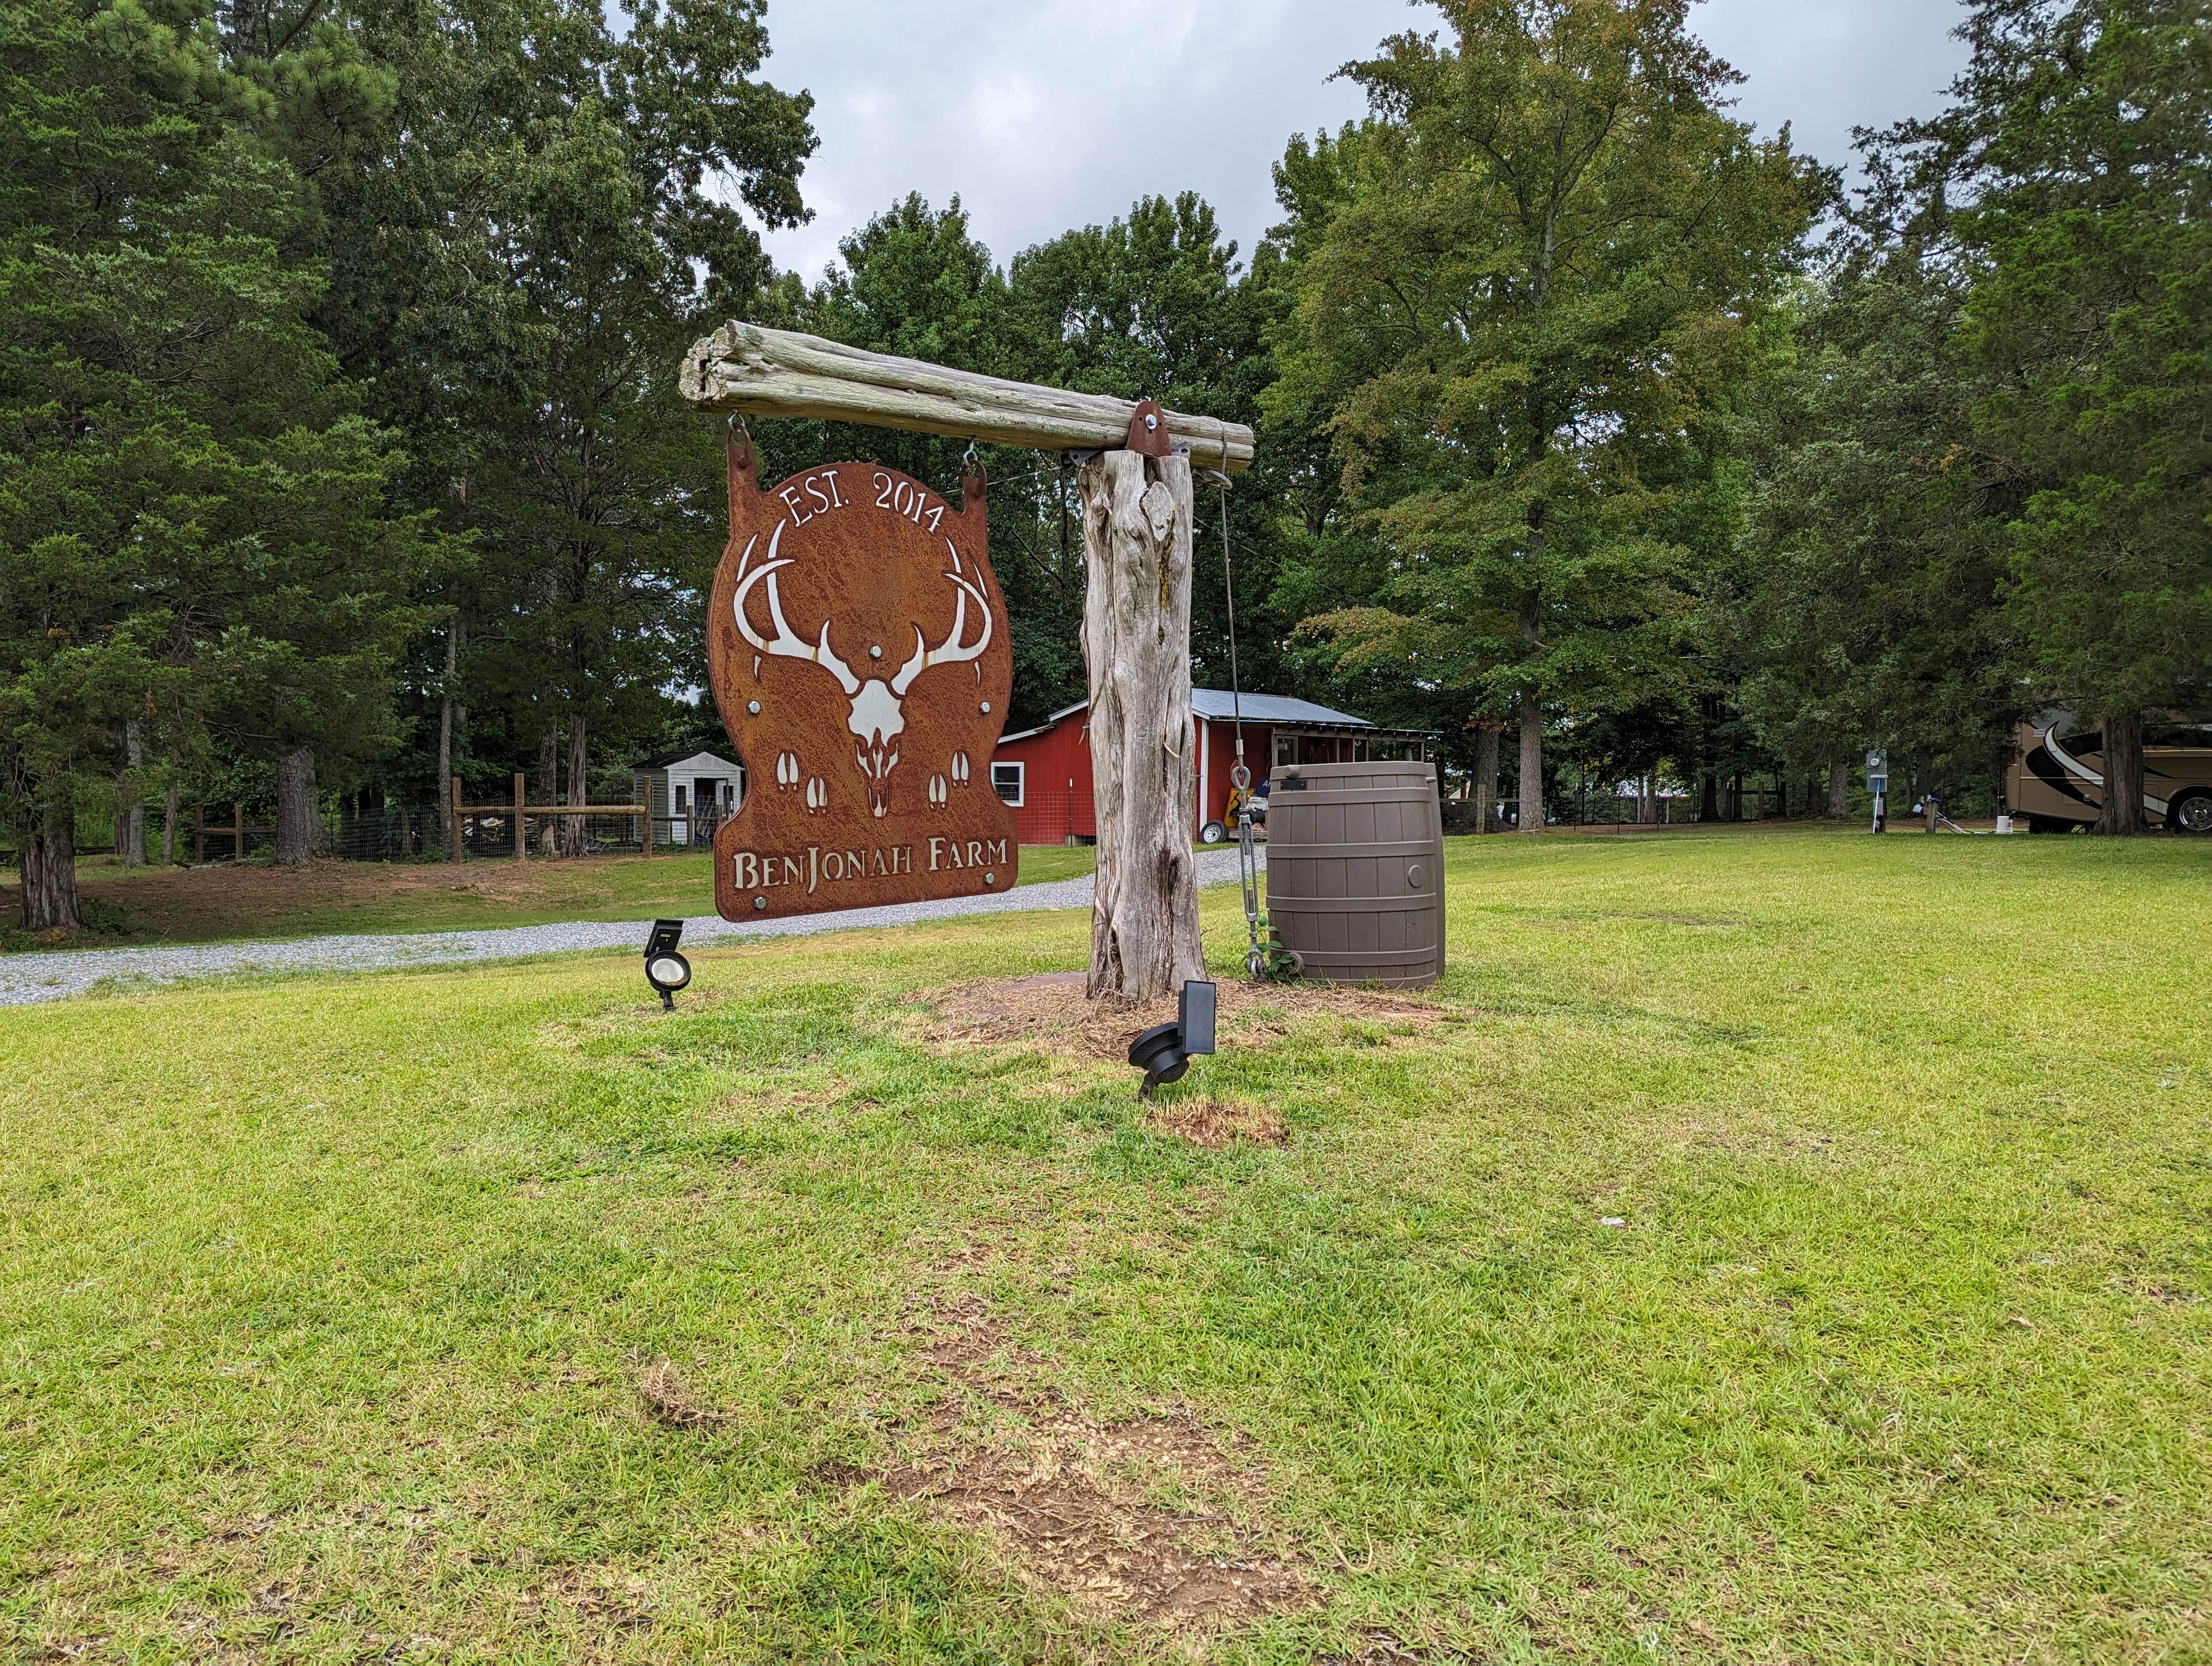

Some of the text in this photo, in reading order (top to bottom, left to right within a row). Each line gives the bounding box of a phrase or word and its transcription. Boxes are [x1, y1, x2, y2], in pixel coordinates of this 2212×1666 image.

[779, 470, 946, 534] EST. 2014
[733, 836, 1008, 894] BENJONAH FARM
